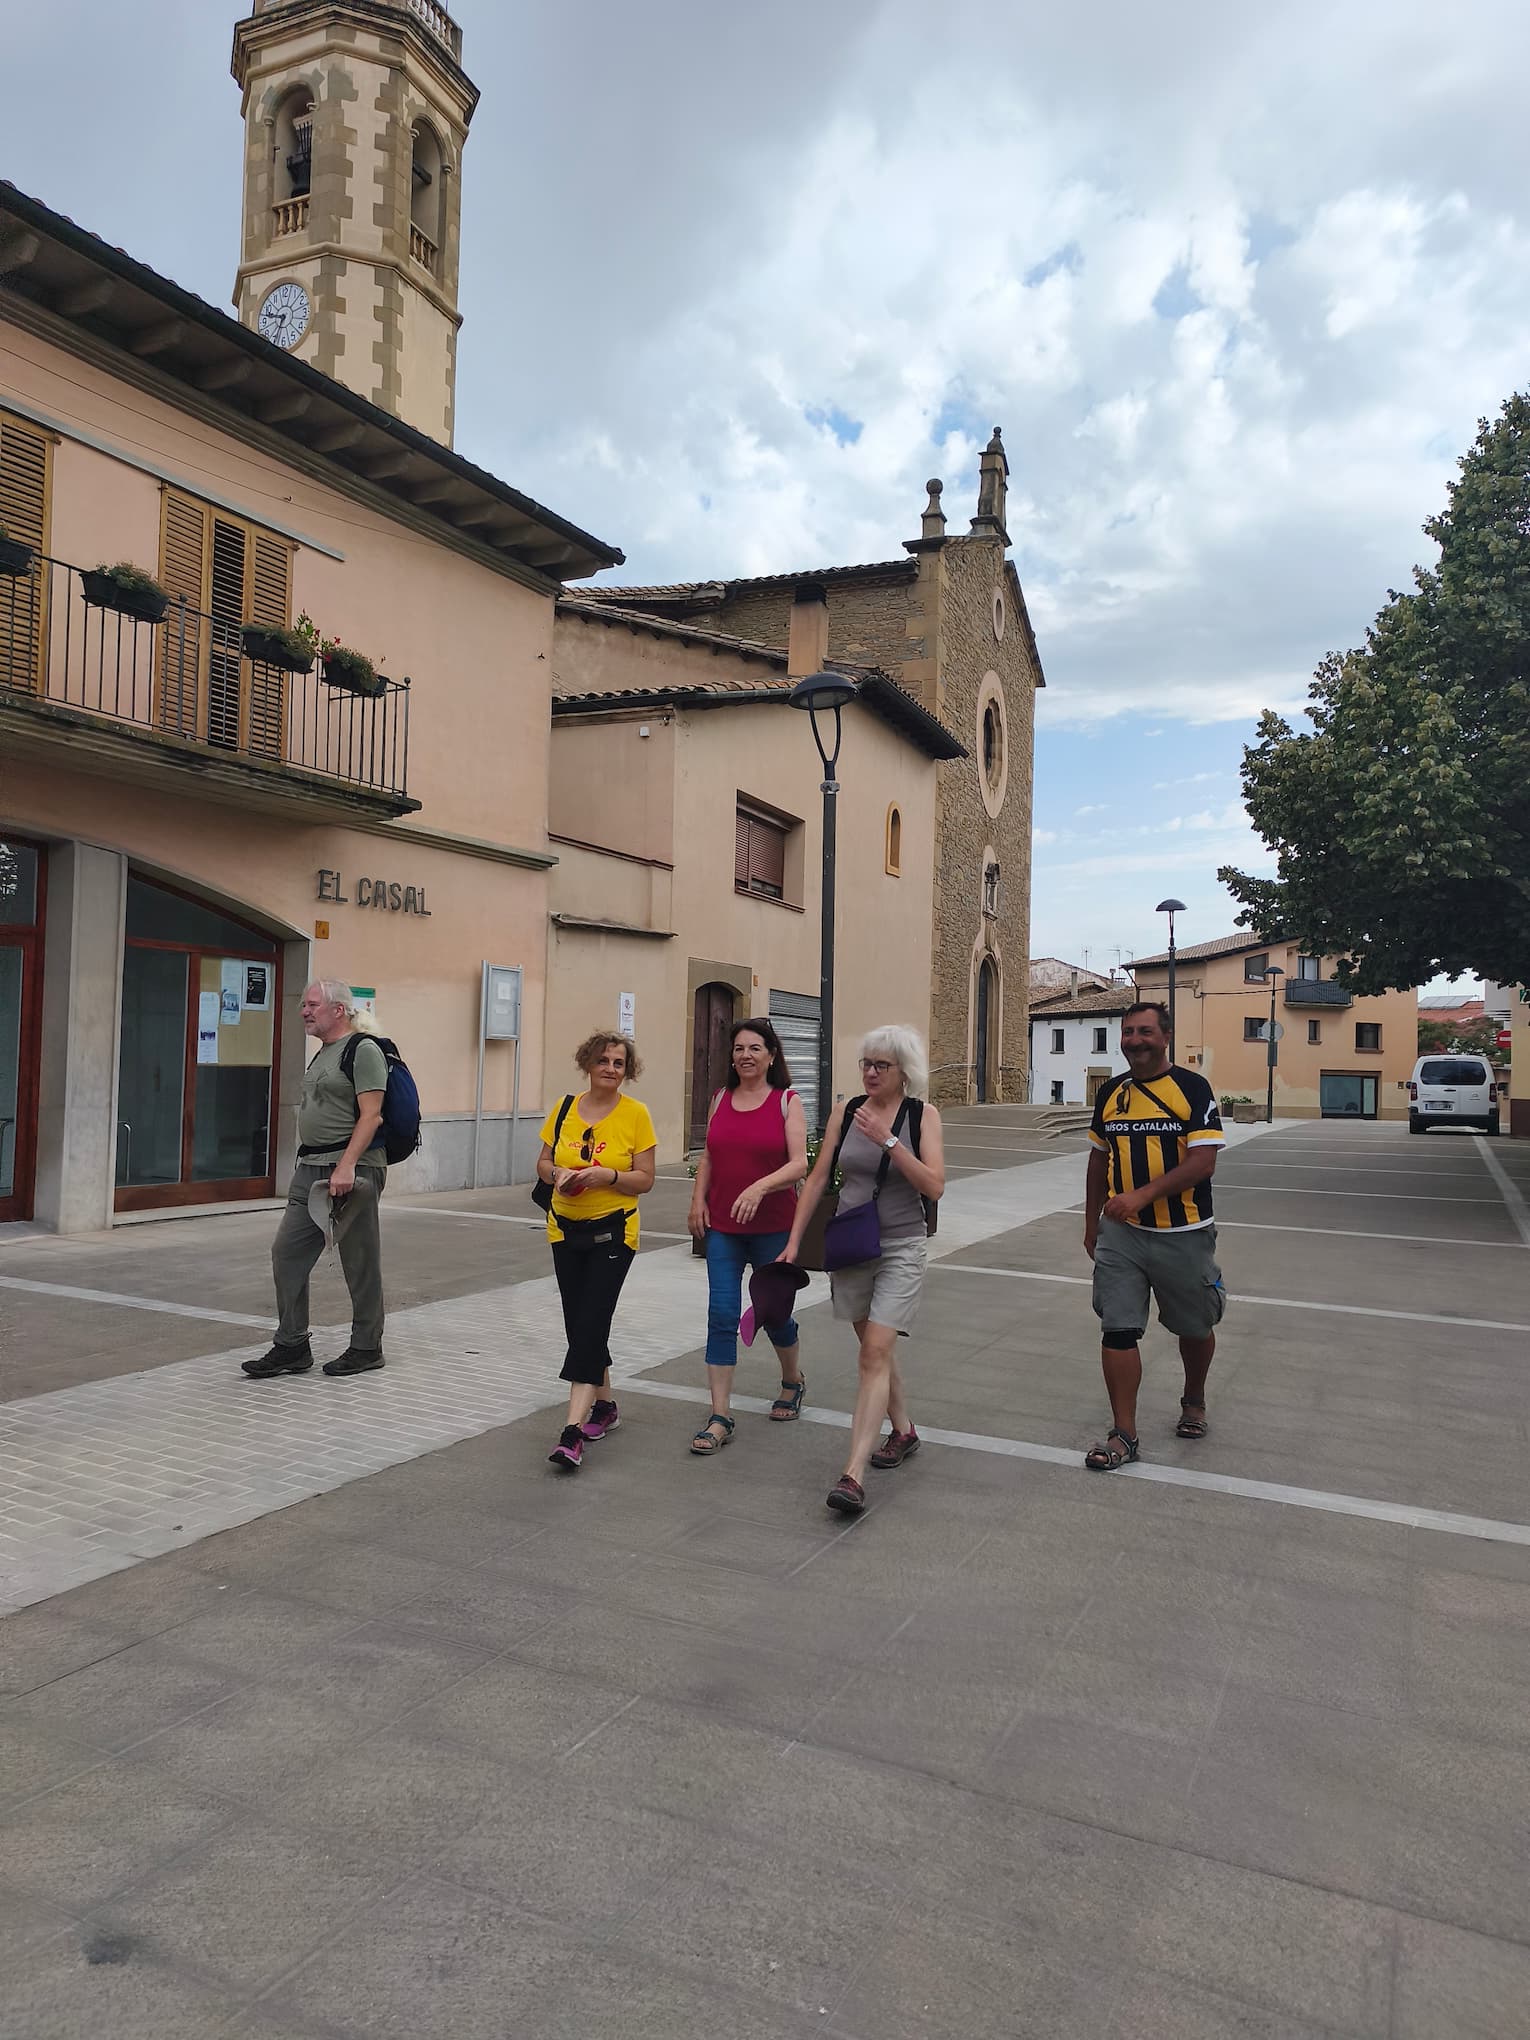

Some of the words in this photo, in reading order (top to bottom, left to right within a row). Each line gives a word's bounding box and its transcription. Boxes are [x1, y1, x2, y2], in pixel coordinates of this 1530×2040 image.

[282, 287, 289, 298] 12
[273, 294, 278, 304] 11
[299, 295, 305, 305] 2
[302, 307, 308, 318] 3
[262, 317, 267, 327] 9
[298, 321, 304, 330] 4
[290, 331, 296, 341] 5
[281, 336, 286, 347] 6
[318, 869, 349, 902] EL
[358, 877, 432, 916] CASAL
[1132, 1121, 1183, 1132] CATALANS
